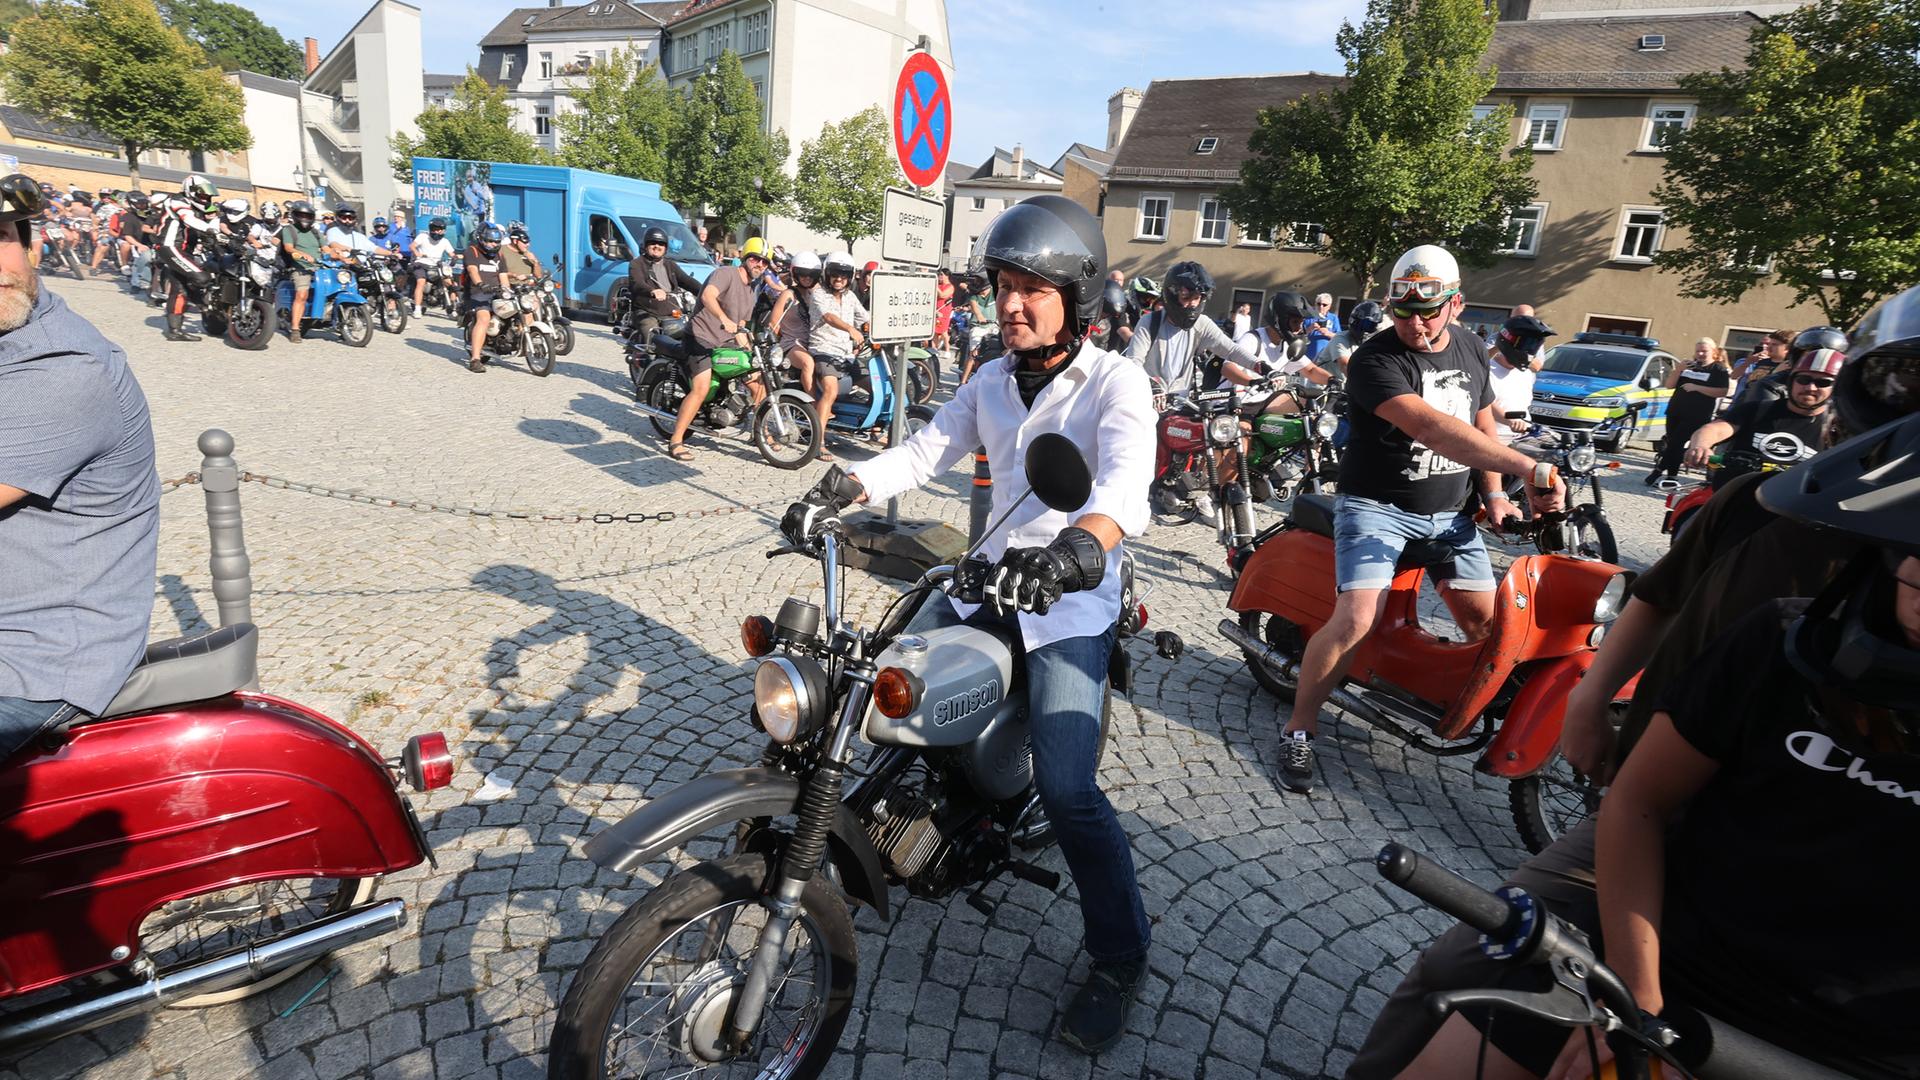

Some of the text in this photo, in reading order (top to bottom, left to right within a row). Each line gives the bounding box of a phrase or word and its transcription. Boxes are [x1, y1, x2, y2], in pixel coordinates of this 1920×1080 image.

[417, 170, 446, 185] FREIE
[417, 186, 451, 202] FAHRT
[417, 202, 452, 218] für alle!
[899, 212, 932, 229] gesamter
[905, 232, 924, 249] Platz
[1198, 390, 1231, 401] domino
